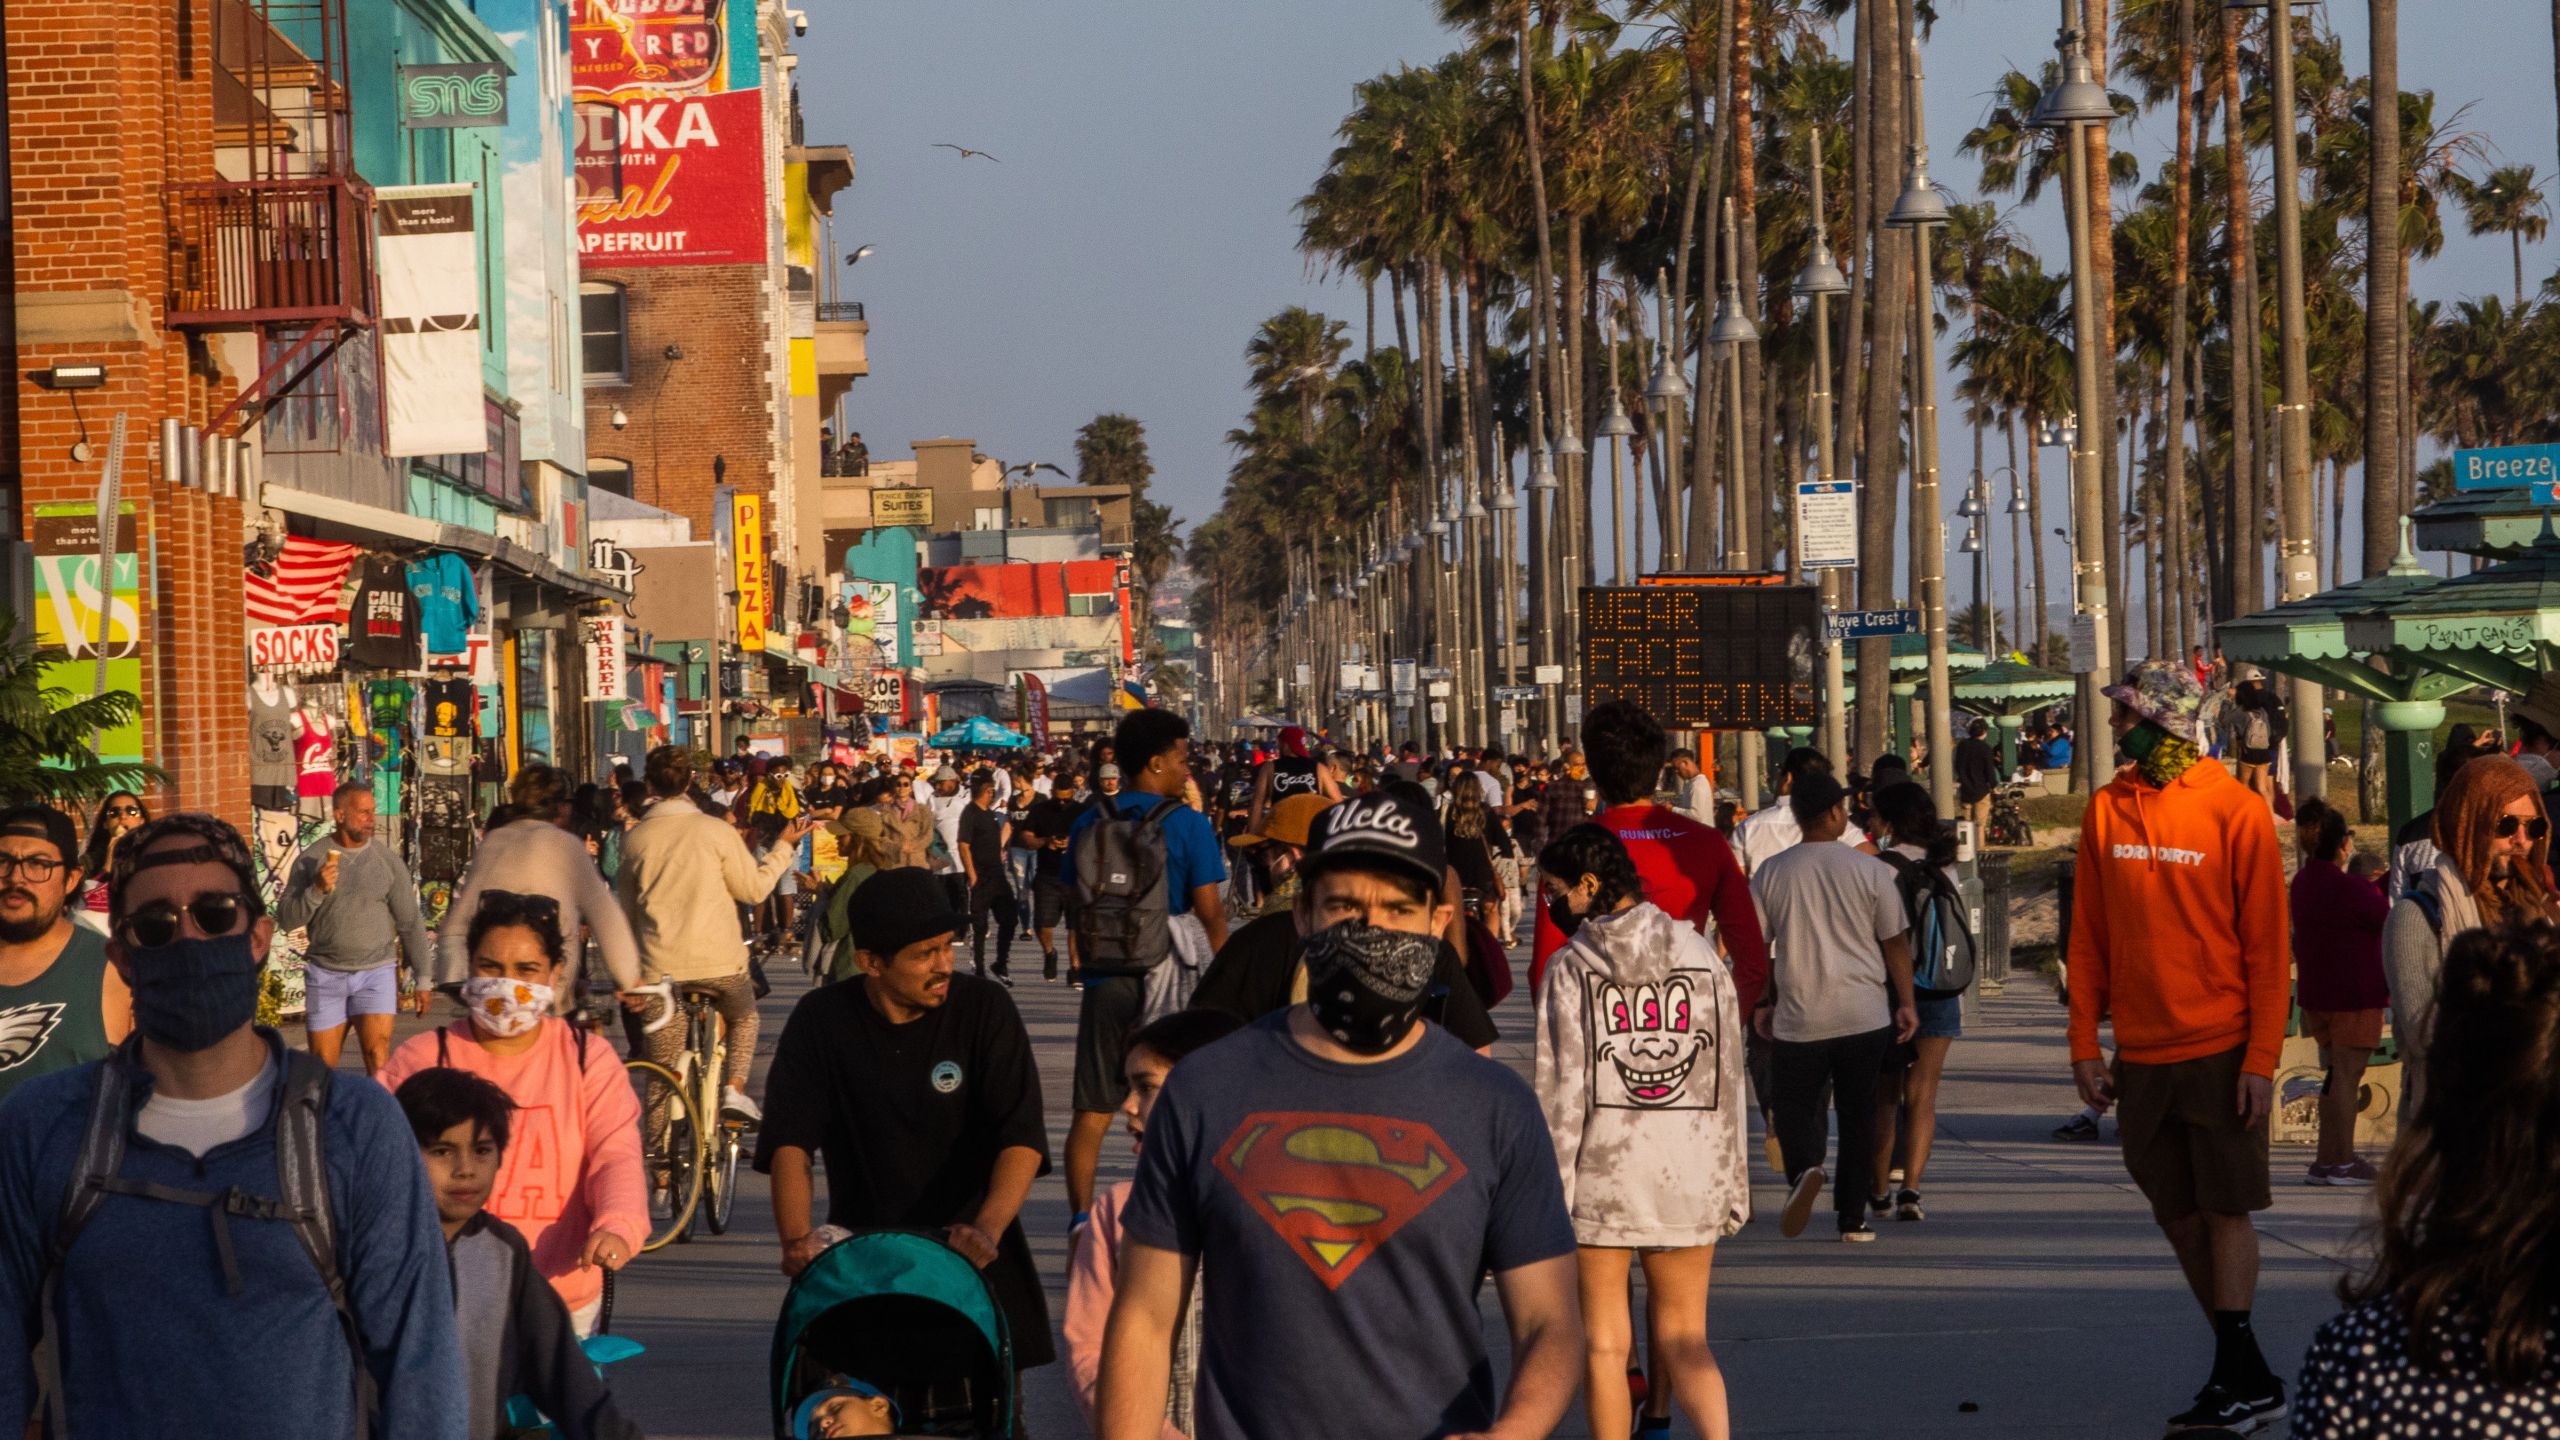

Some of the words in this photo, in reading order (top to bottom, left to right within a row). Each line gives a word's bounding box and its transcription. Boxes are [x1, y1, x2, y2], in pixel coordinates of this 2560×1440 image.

[646, 31, 710, 55] RED
[412, 207, 436, 215] more
[429, 216, 455, 225] hotel
[2468, 456, 2551, 480] Breeze
[882, 500, 923, 511] SUITES
[71, 526, 97, 535] more
[55, 537, 78, 545] than
[740, 505, 761, 641] PIZZA
[1589, 592, 1699, 631] WEAR
[1827, 613, 1860, 628] Wave
[1865, 612, 1900, 627] Crest
[2480, 626, 2524, 642] GANG
[255, 626, 337, 666] SOCKS
[596, 620, 615, 696] MARKET
[1590, 638, 1700, 676] FACE
[1619, 828, 1672, 840] RUNNYC
[2157, 846, 2206, 867] DIRTY
